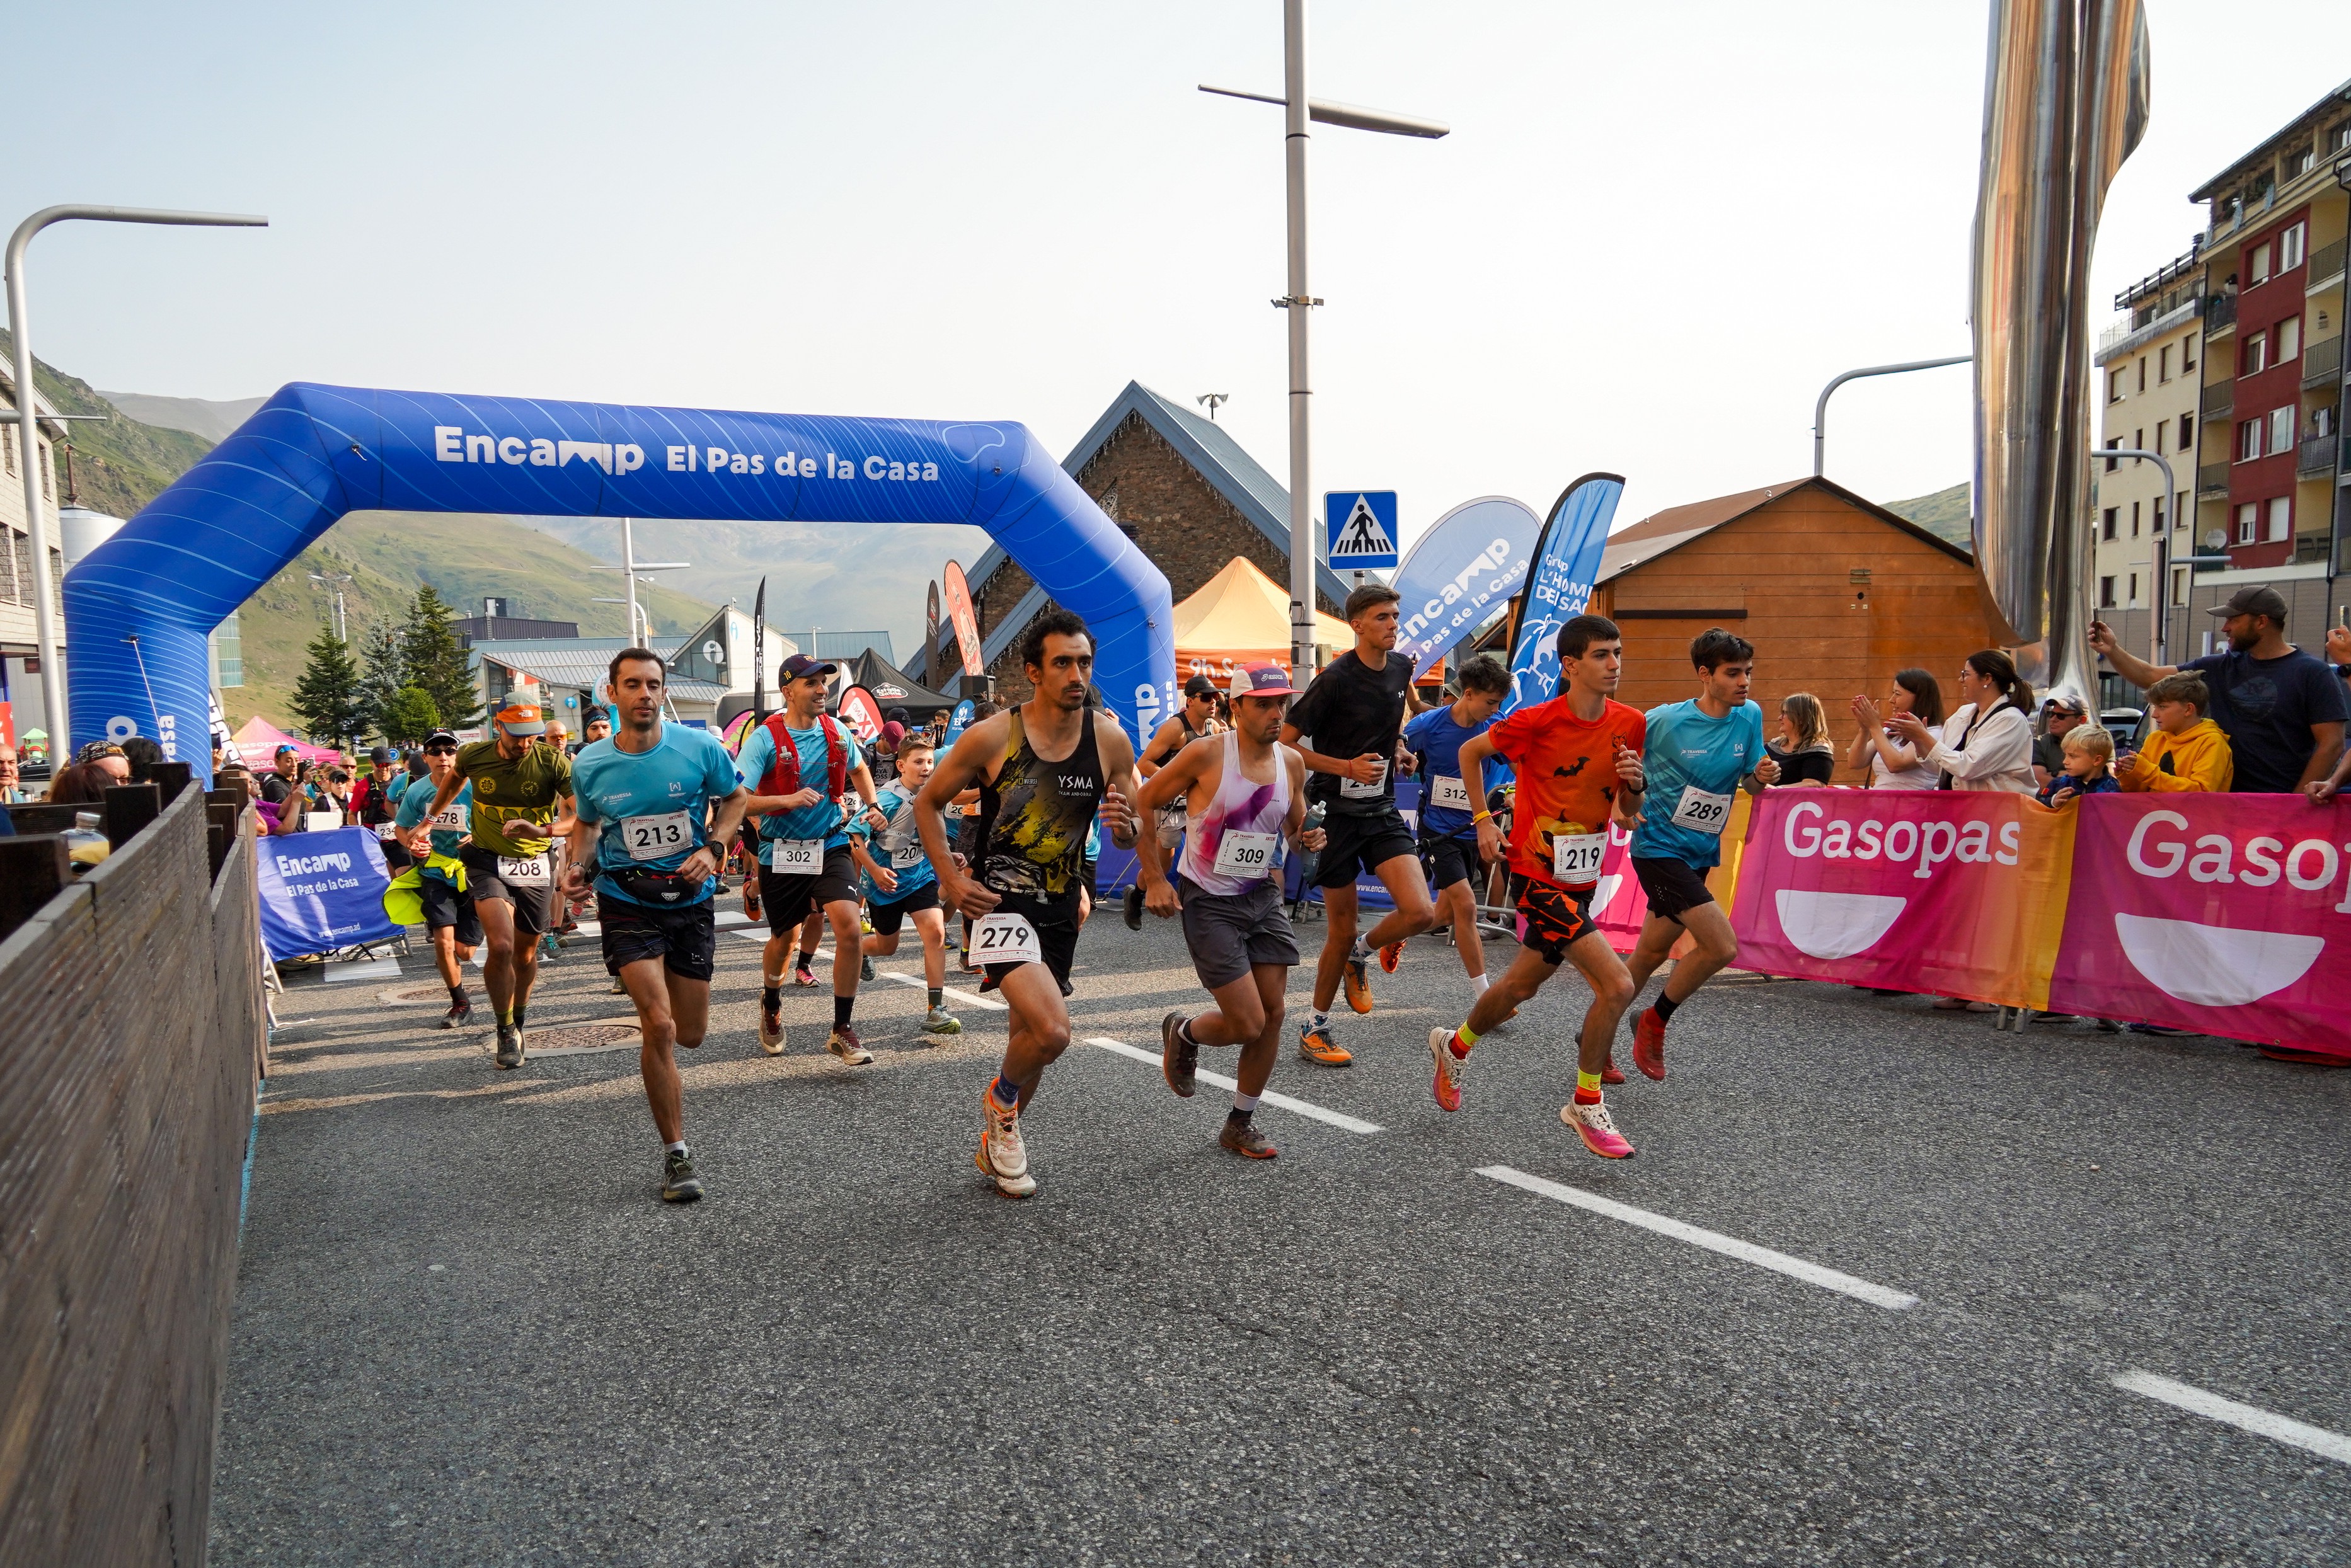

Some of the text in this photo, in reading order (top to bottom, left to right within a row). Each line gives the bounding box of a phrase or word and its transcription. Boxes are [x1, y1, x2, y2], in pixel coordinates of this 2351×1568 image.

[435, 426, 938, 481] Encamp El Pas de la Casa
[1546, 554, 1568, 573] Grup
[1420, 626, 1451, 653] Pas
[1451, 607, 1473, 627] de
[1471, 593, 1490, 609] la
[1490, 559, 1529, 592] Casa
[783, 670, 791, 680] 10
[159, 716, 176, 762] asa
[1058, 775, 1093, 789] YSMA
[1444, 787, 1467, 800] 312
[1684, 801, 1723, 821] 289
[635, 825, 681, 847] 213
[1785, 801, 2020, 878] Gasopas
[786, 850, 811, 862] 302
[899, 847, 918, 860] 20
[1234, 848, 1264, 864] 309
[1566, 847, 1601, 870] 219
[276, 852, 351, 878] Encamp
[508, 862, 541, 876] 208
[286, 878, 359, 897] El Pas de la Casa
[980, 927, 1029, 949] 279
